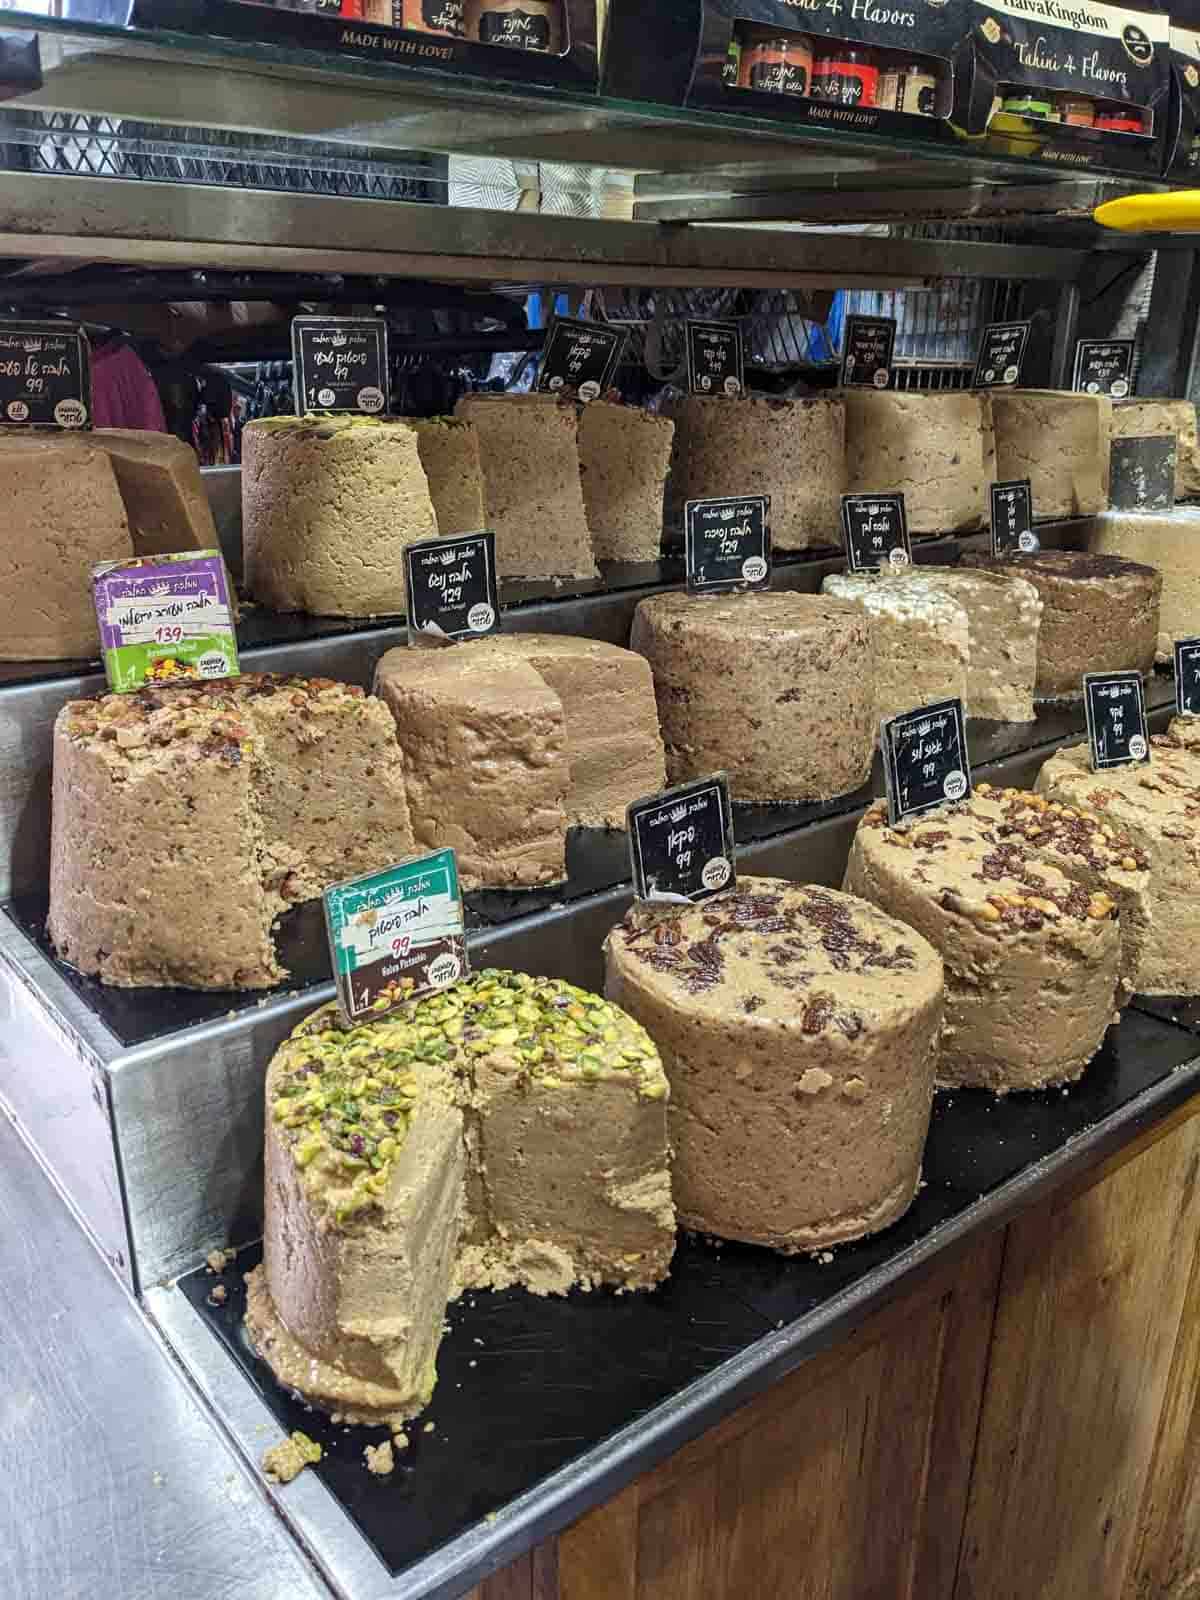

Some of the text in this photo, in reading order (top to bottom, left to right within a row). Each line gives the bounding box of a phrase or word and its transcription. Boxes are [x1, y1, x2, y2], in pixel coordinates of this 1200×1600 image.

[850, 0, 916, 27] Flavors
[341, 30, 381, 49] MADE
[383, 38, 416, 55] WITH
[1014, 37, 1128, 85] Tahini 4 Flavors
[334, 366, 349, 380] 99
[26, 378, 44, 393] 99
[720, 540, 738, 553] 129
[872, 536, 883, 549] 99
[441, 587, 462, 604] 129
[155, 627, 182, 642] 139
[1112, 723, 1123, 737] 99
[922, 762, 936, 778] 99
[667, 825, 695, 857] פקאן
[675, 850, 691, 869] 99
[368, 897, 430, 947] חלבה פיסטוק
[391, 936, 411, 954] 99
